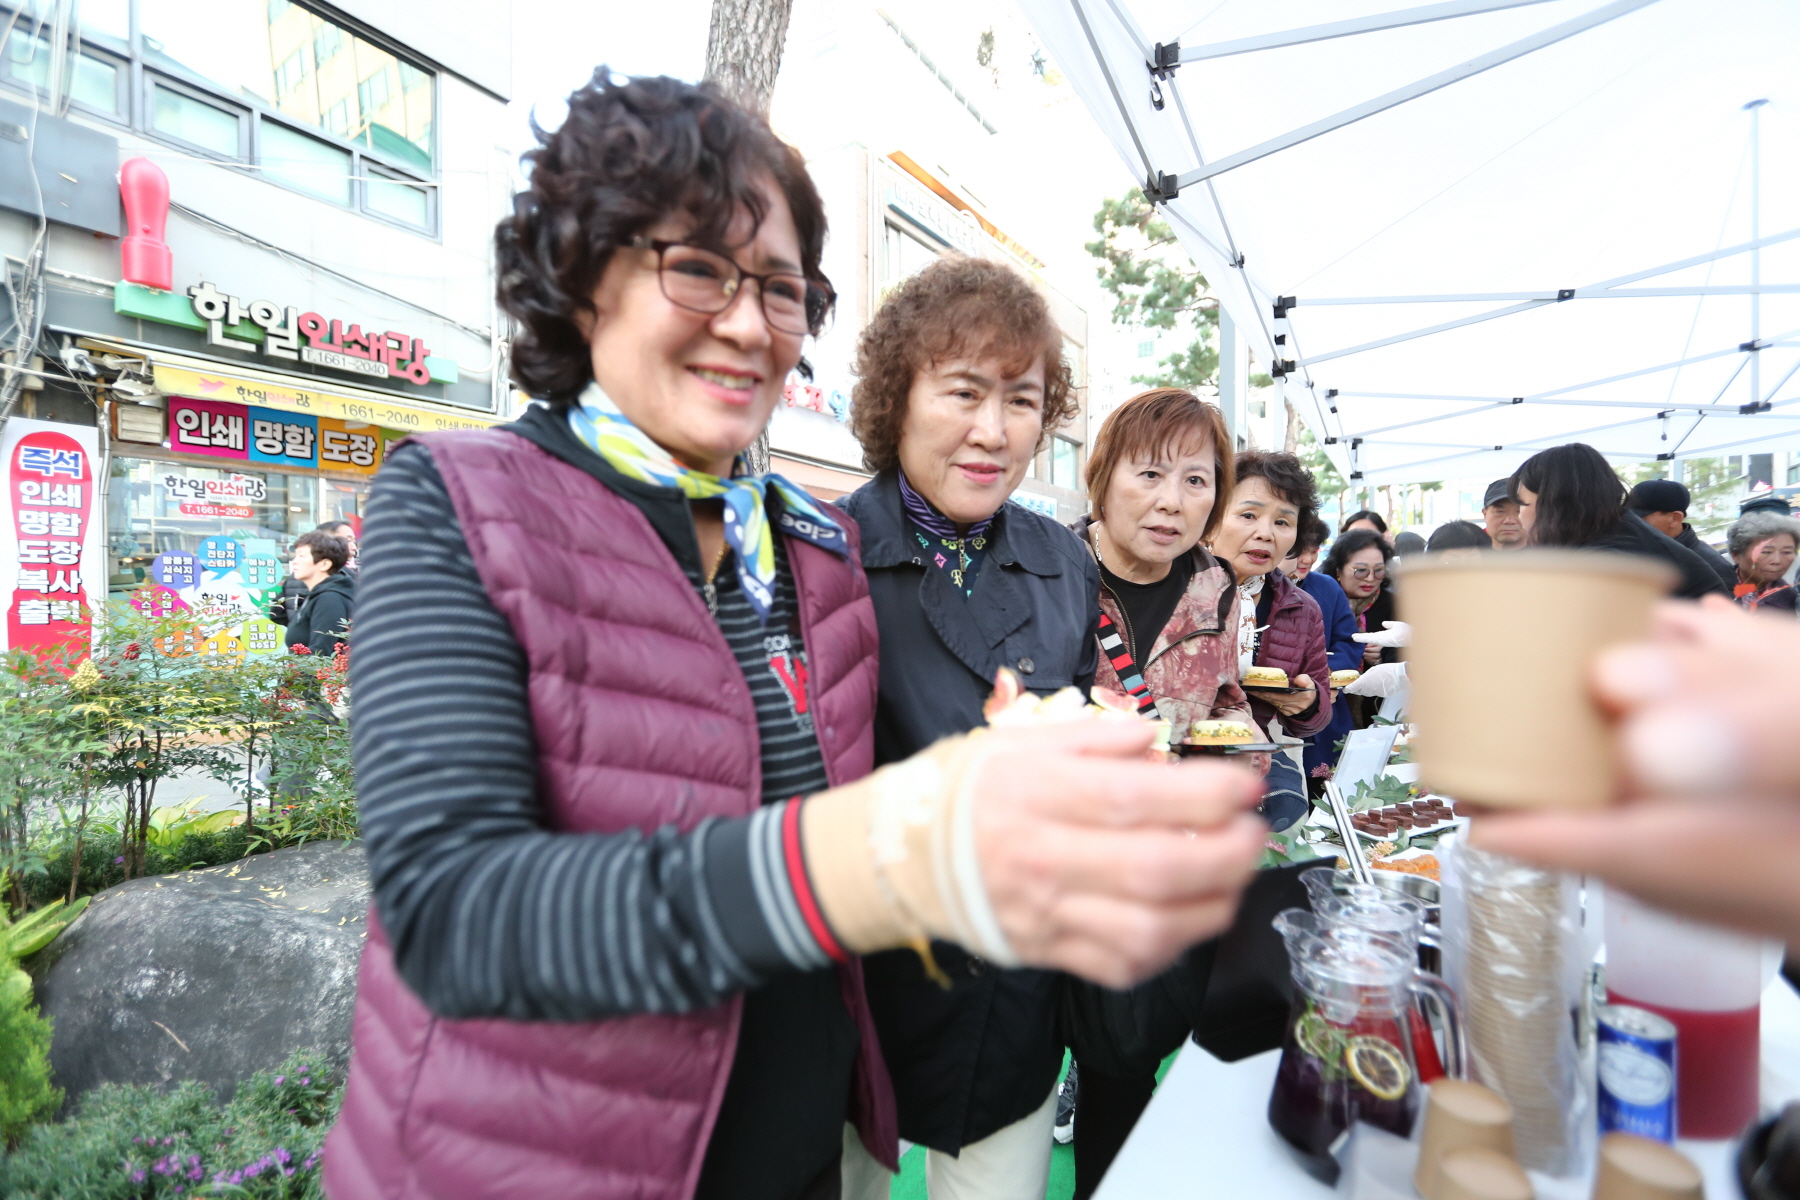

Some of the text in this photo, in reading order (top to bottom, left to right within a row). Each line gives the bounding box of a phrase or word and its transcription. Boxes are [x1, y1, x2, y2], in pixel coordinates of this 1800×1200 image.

[187, 281, 431, 385] 한일인쇄랑
[305, 348, 386, 376] T.1661-2040
[236, 385, 311, 408] 한일인쇄랑
[341, 403, 419, 426] 1661-2040
[175, 408, 245, 450] 인쇄
[253, 418, 315, 459] 명함
[322, 430, 377, 467] 도장
[20, 446, 83, 478] 즉석
[18, 480, 82, 508] 인쇄
[164, 475, 264, 498] 한일인쇄랑
[18, 509, 82, 537] 명함
[185, 504, 250, 517] T.1661-2040
[17, 539, 82, 565] 도장
[17, 569, 82, 593] 복사
[18, 599, 81, 625] 출력
